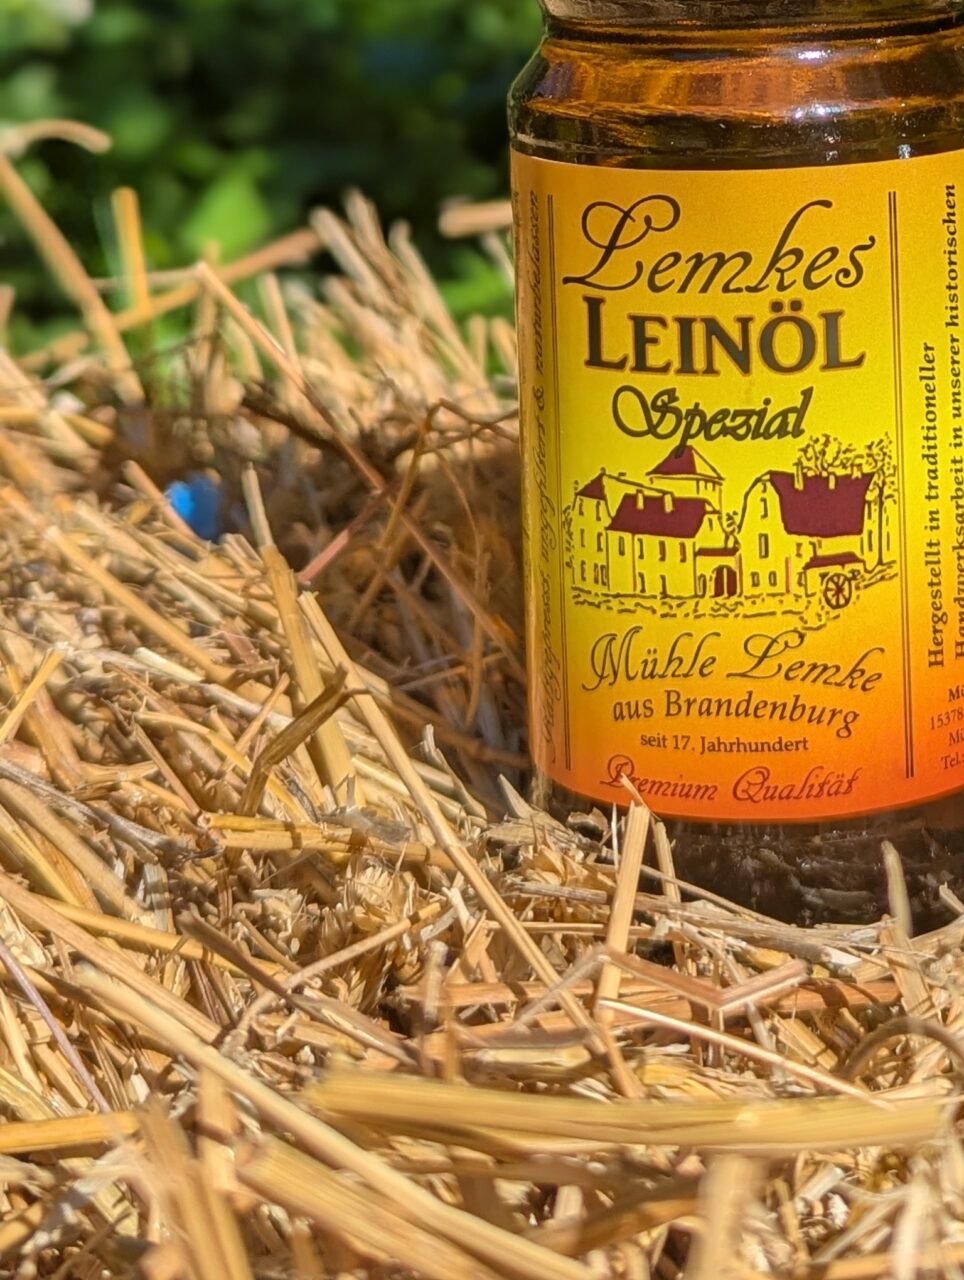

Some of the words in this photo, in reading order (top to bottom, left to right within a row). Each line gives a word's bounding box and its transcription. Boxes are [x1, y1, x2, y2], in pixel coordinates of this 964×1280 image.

[562, 194, 876, 294] Lemkes
[942, 184, 958, 328] historischen
[581, 295, 867, 376] LEINÖL
[531, 385, 544, 411] &
[947, 335, 961, 418] unserer
[612, 384, 814, 450] Spezial
[919, 342, 940, 501] traditioneller
[948, 427, 963, 449] in
[924, 510, 940, 531] in
[925, 539, 948, 667] Hergestellt
[582, 625, 721, 691] Mühle
[726, 630, 886, 693] Lemke
[612, 698, 654, 721] aus
[664, 689, 861, 739] Brandenburg
[640, 732, 668, 748] seit
[672, 735, 696, 752] 17.
[700, 735, 809, 755] Jahrhundert
[930, 707, 964, 730] 15378
[600, 754, 719, 801] Premium
[732, 766, 863, 803] Qualität
